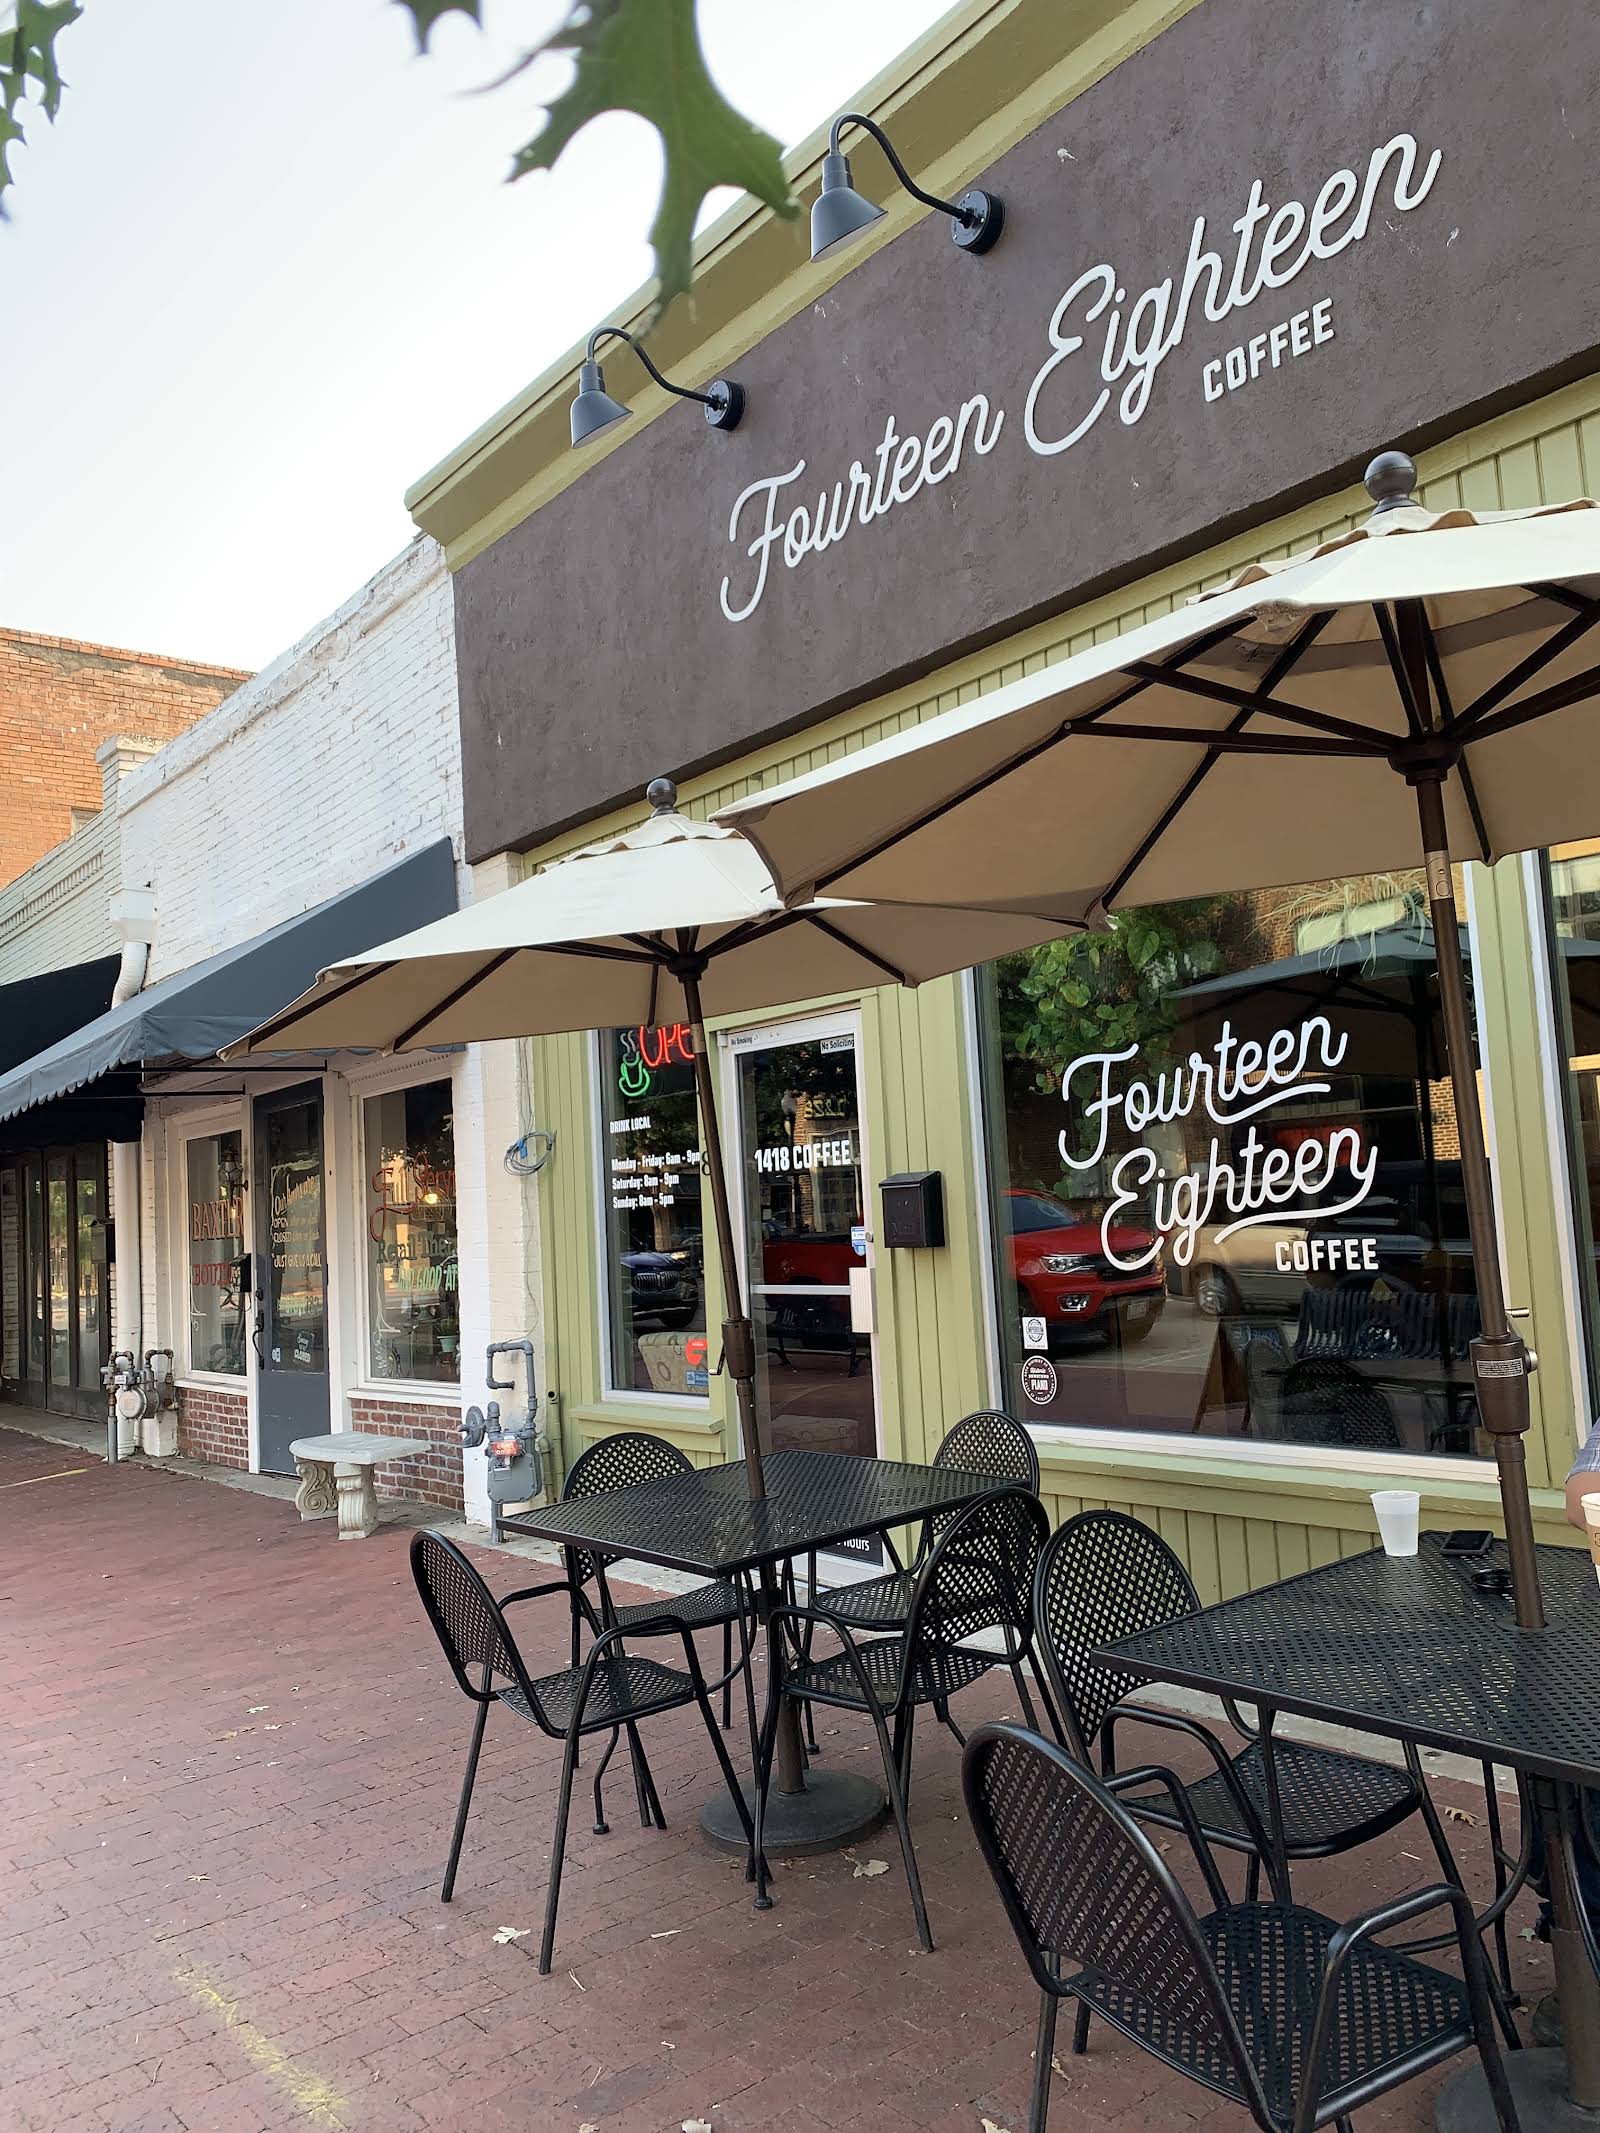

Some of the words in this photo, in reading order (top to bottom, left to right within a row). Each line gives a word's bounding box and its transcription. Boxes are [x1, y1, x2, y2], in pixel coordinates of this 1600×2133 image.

[1202, 297, 1335, 403] COFFEE
[719, 393, 1005, 623] Fourteen
[1023, 133, 1443, 456] Eighteen
[640, 1024, 695, 1067] OPE
[821, 1041, 829, 1050] No
[829, 1038, 855, 1049] Soliciting
[1058, 1016, 1348, 1170] Fourteen
[609, 1119, 630, 1134] DRINK
[631, 1116, 651, 1131] LOCAL
[611, 1157, 636, 1171] Monday
[641, 1154, 665, 1168] Friday:
[665, 1152, 681, 1165] 6am
[754, 1146, 791, 1173] 1418
[792, 1139, 852, 1171] COFFEE
[612, 1176, 643, 1190] Saturday:
[644, 1174, 658, 1187] 8am
[664, 1172, 679, 1187] 9pm
[613, 1196, 638, 1210] Sunday:
[639, 1194, 653, 1207] 8am
[659, 1192, 674, 1207] 5pm
[1100, 1126, 1379, 1271] Eighteen
[191, 1197, 244, 1241] BAXTER
[1274, 1238, 1379, 1272] COFFEE
[1031, 1379, 1049, 1391] PLANO
